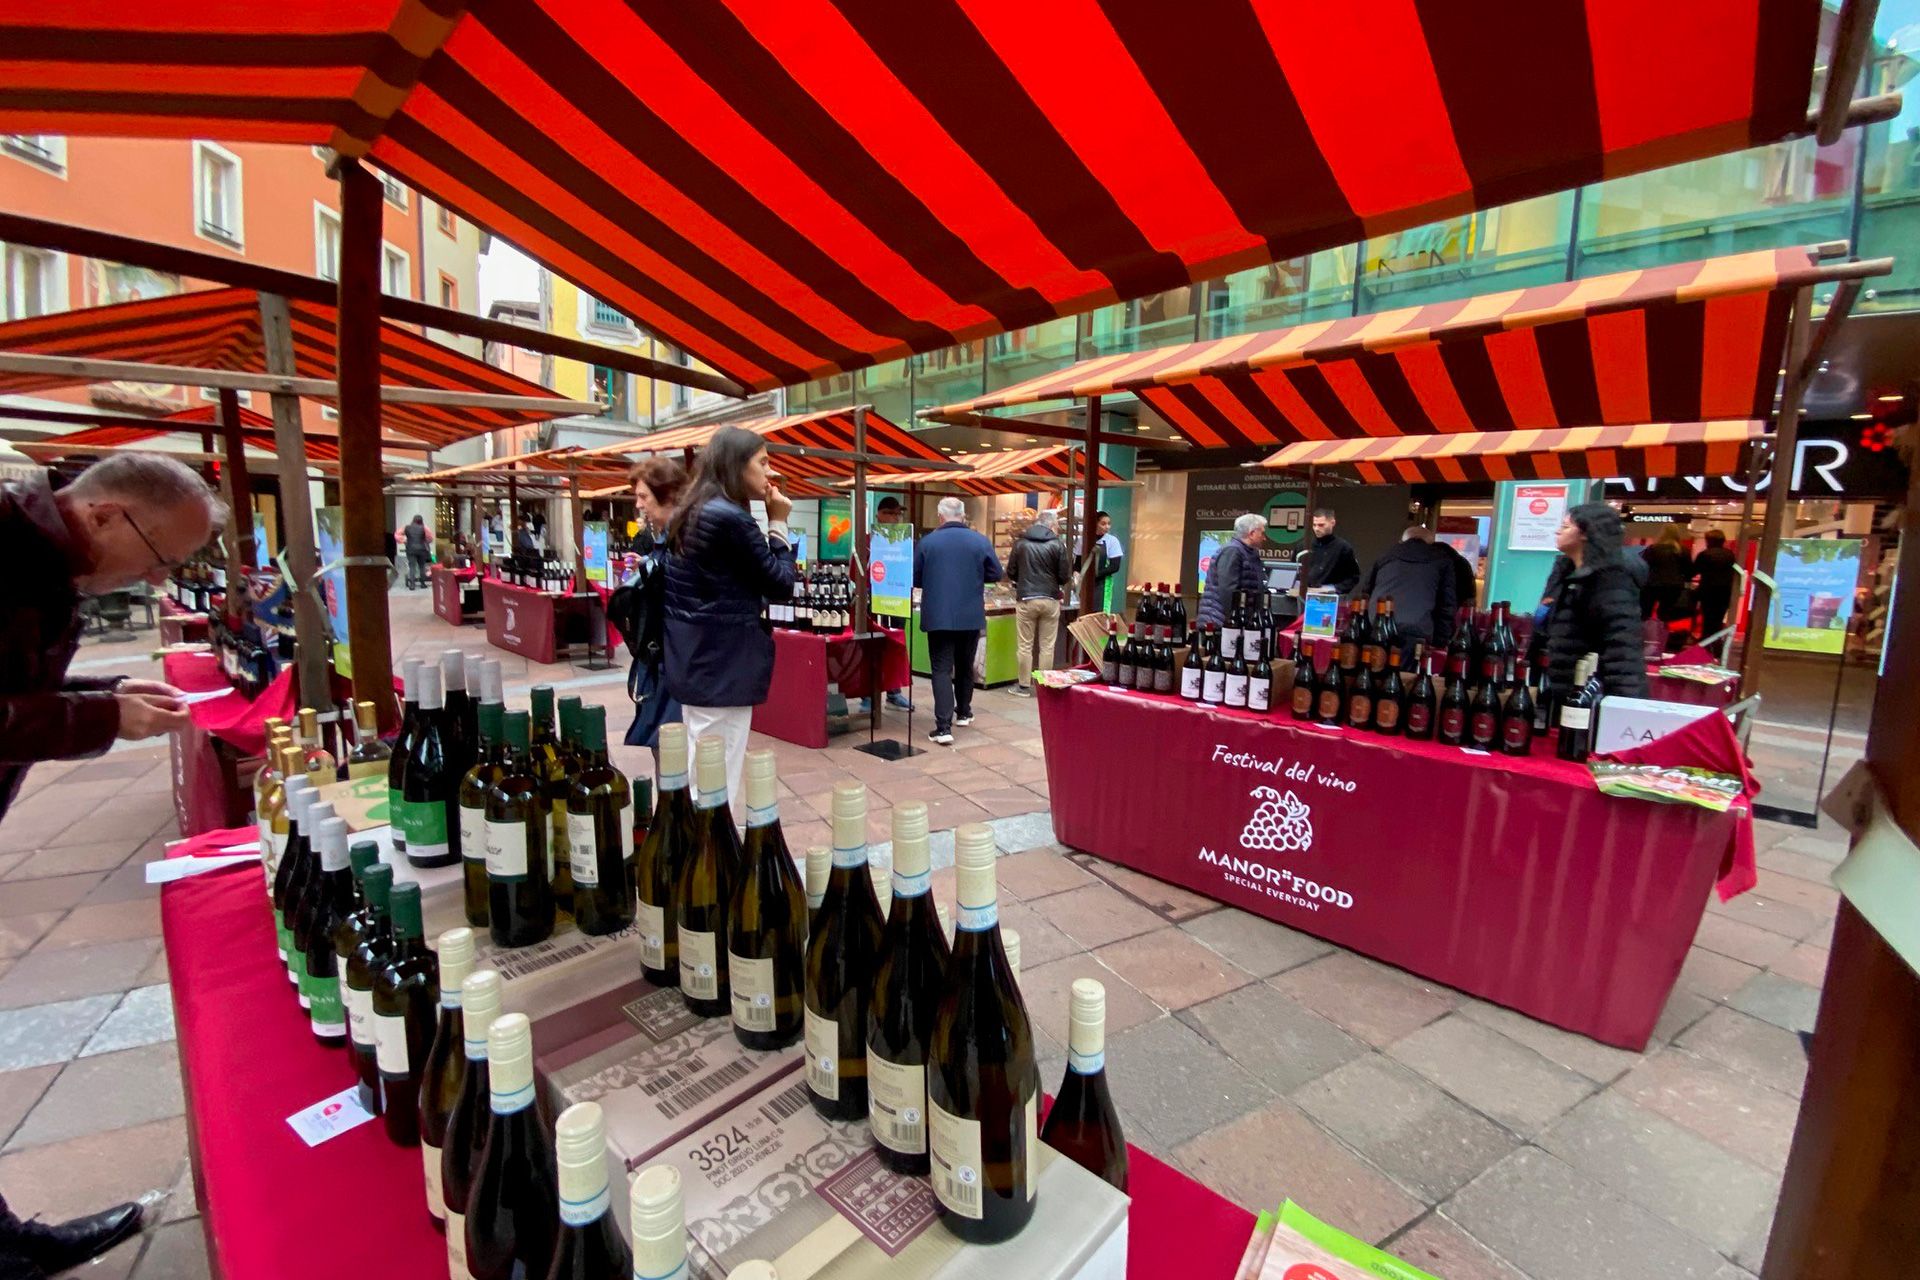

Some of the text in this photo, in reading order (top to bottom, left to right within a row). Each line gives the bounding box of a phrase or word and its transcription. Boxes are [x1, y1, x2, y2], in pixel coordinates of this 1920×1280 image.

[1242, 482, 1271, 491] GRANDE
[1196, 508, 1215, 518] Click
[1633, 515, 1675, 523] CHANEL
[1212, 744, 1357, 792] Festival del vino
[1198, 846, 1354, 909] MANOR FOOD
[1223, 872, 1320, 912] SPECIAL EVERYDAY
[688, 1125, 751, 1172] 3524
[705, 1163, 729, 1181] PINOT
[713, 1174, 732, 1189] DOC
[881, 1190, 932, 1232] CECILIA
[888, 1201, 934, 1240] BERETT
